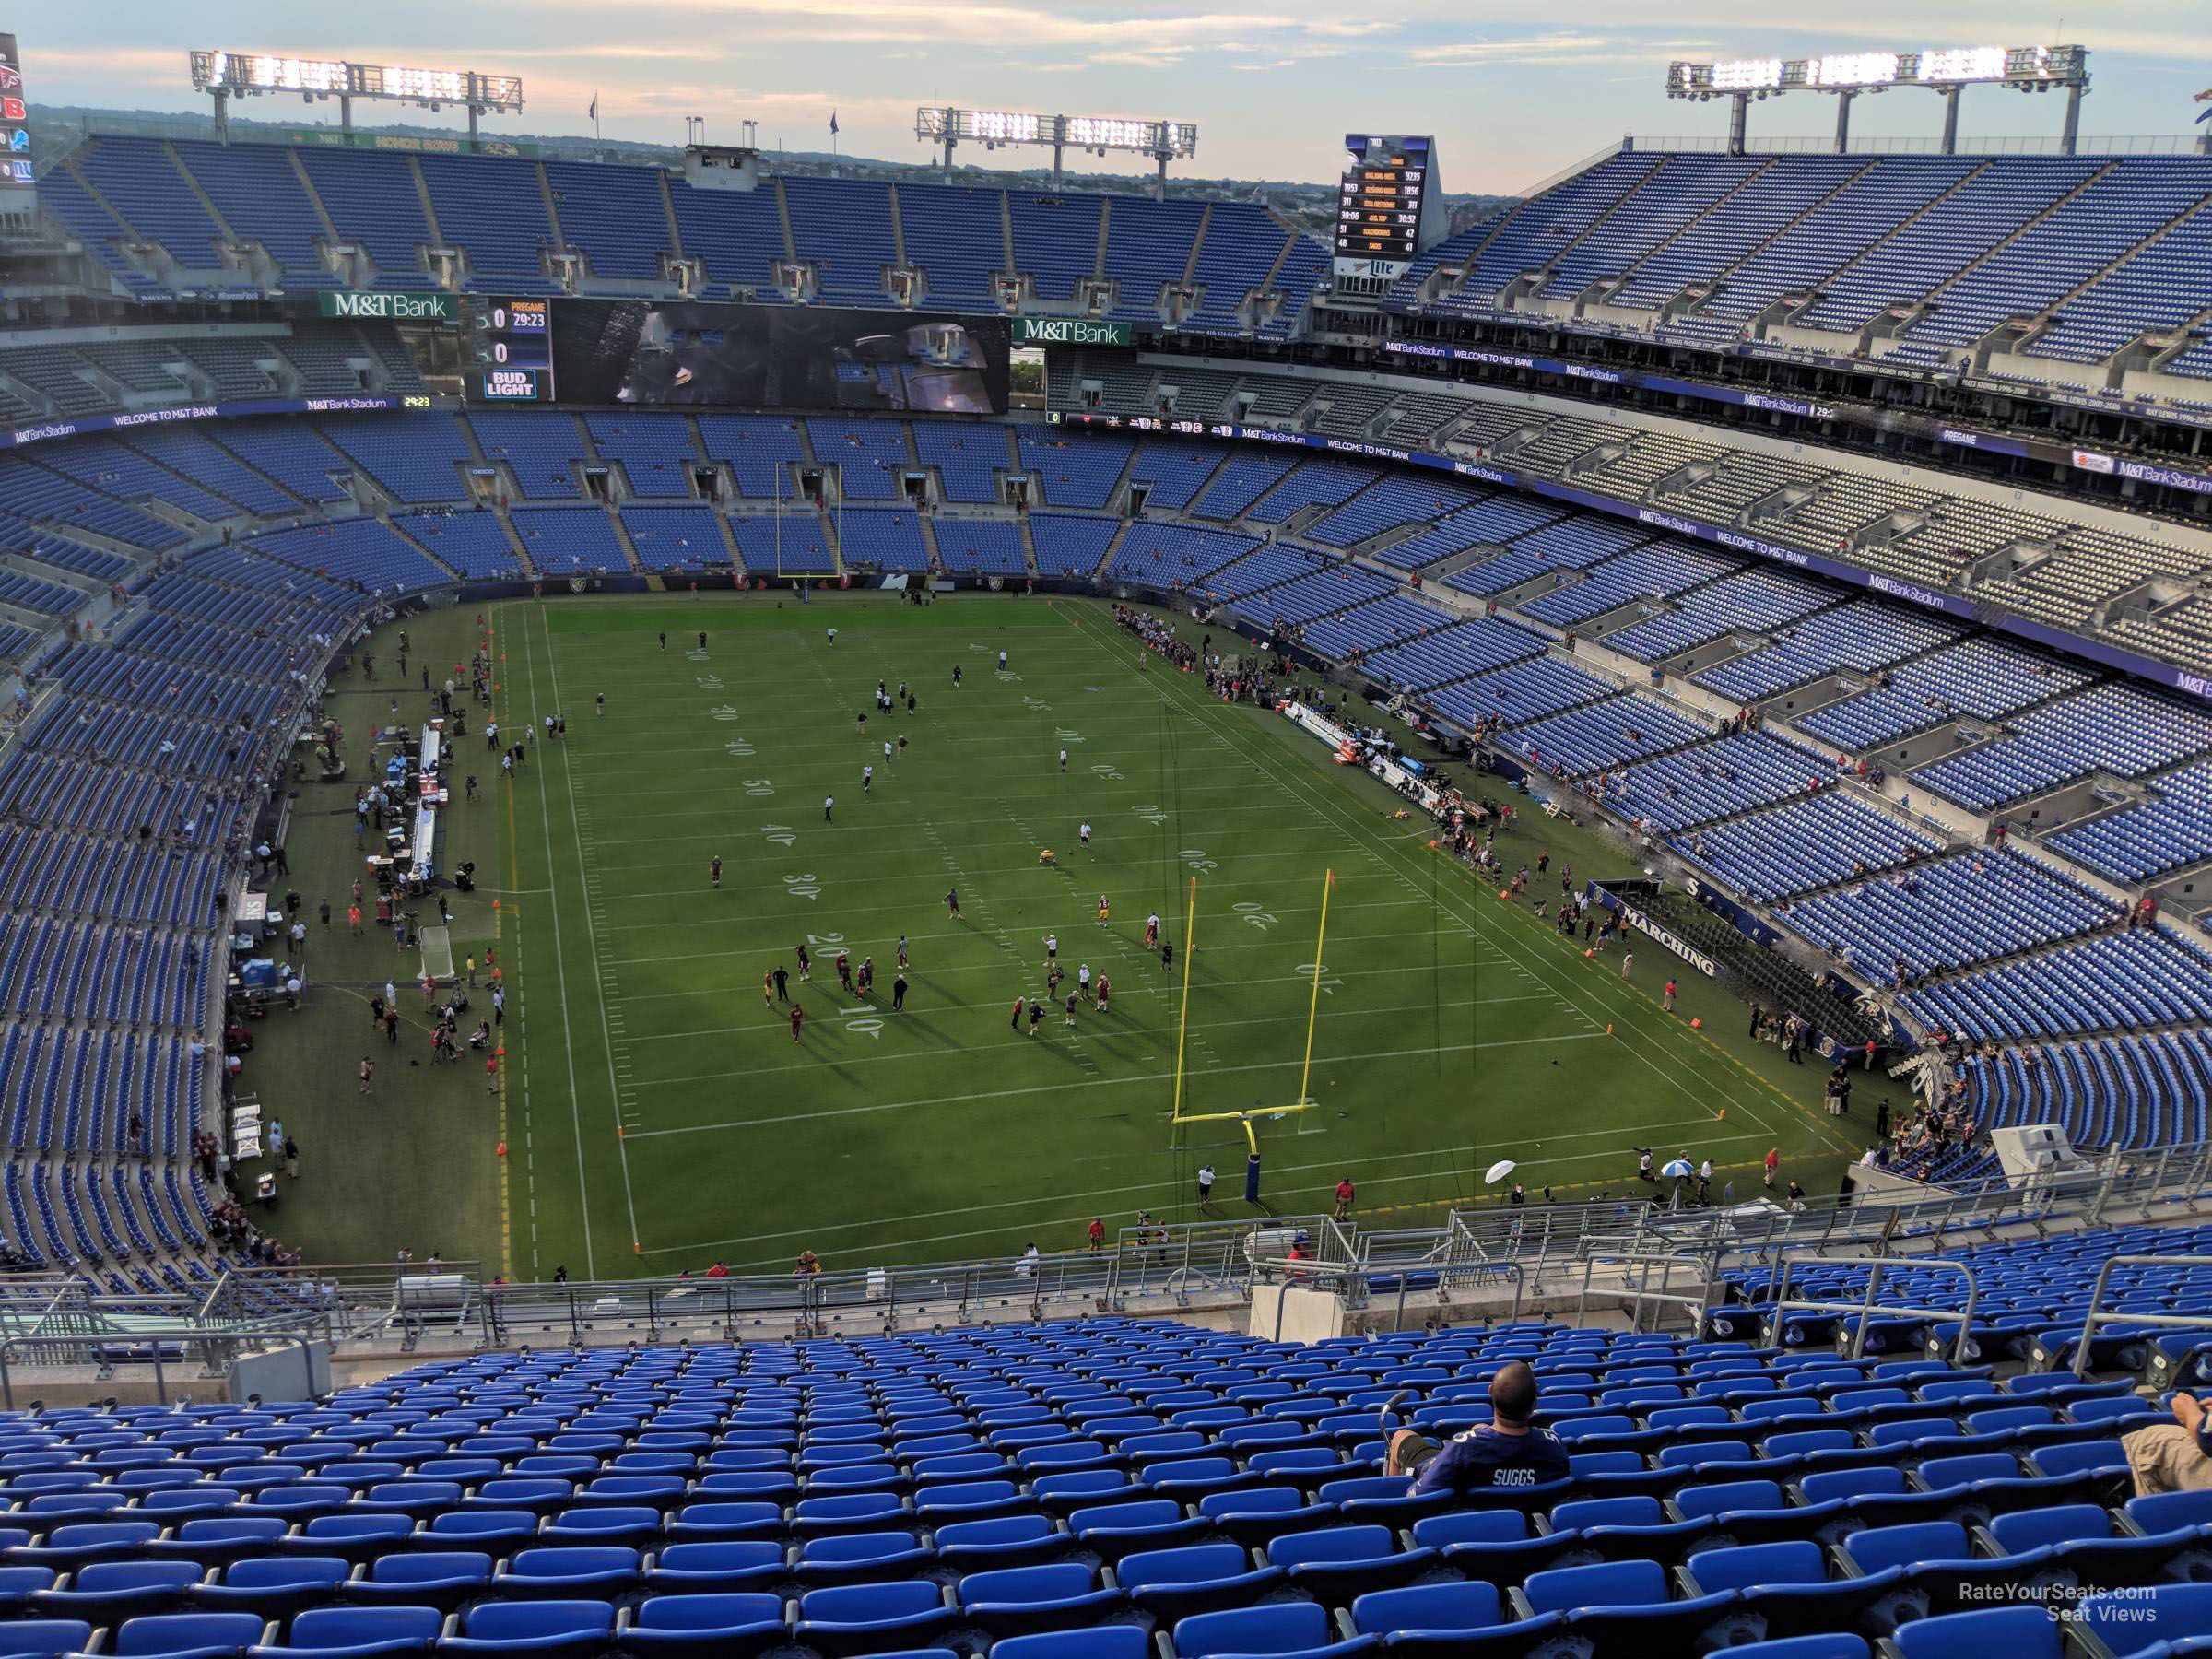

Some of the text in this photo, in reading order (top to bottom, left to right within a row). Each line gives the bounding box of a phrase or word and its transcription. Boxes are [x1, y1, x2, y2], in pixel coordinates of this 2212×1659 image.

[1405, 186, 1418, 195] 1856
[1406, 229, 1414, 238] 42
[1371, 260, 1394, 276] Lite
[334, 293, 446, 318] M&T Bank
[511, 301, 546, 312] PREGAME
[494, 309, 505, 328] 0
[513, 313, 545, 327] 29:23
[1025, 319, 1120, 344] M&T Bank
[495, 343, 507, 363] 0
[1386, 342, 1445, 358] M&T Bank Stadium
[1454, 349, 1533, 368] WELCOME TO M&T BANK
[493, 371, 526, 384] BUD
[1565, 365, 1618, 382] M&T Bank Stadium
[1853, 363, 1878, 373] JONATHAN
[1879, 367, 1896, 375] OGDEN
[487, 383, 533, 396] LIGHT
[1977, 381, 1997, 392] STOVER
[307, 397, 386, 410] M&T Bank Stadium
[405, 397, 429, 407] 29:23
[1744, 394, 1761, 406] M&T
[1761, 395, 1779, 408] Bank
[1779, 398, 1806, 414] Stadium
[2050, 393, 2067, 403] JAMAL
[2068, 394, 2087, 406] LEWIS
[114, 406, 218, 426] WELCOME TO M&T BANK
[1053, 413, 1059, 422] 0
[2146, 407, 2158, 416] RAY
[2159, 409, 2178, 419] LEWIS
[15, 424, 76, 444] M&T Bank Stadium
[1241, 429, 1306, 444] M&T Bank Stadium
[1944, 429, 1976, 445] PREGAME
[1327, 439, 1409, 461] WELCOME TO M&T BANK
[1454, 462, 1502, 482] M&T Bank Stadium
[2119, 461, 2146, 478] M&T
[2145, 466, 2170, 484] Bank
[2170, 471, 2212, 493] Stadium
[1639, 509, 1697, 535] M&T Bank Stadium
[1716, 531, 1808, 567] WELCOME TO M&T BANK
[1868, 574, 1943, 608] M&T Bank Stadium
[2176, 672, 2207, 694] M&T
[1090, 765, 1125, 780] 50
[742, 780, 775, 796] 50
[1131, 805, 1168, 821] 40
[760, 824, 797, 842] 40
[1178, 850, 1218, 869] 30
[782, 874, 821, 895] 30
[1231, 902, 1279, 924] 20
[806, 932, 850, 958] 20
[1624, 905, 1715, 977] MARCHING
[1294, 964, 1344, 986] 10
[839, 1004, 885, 1032] 10
[1492, 1468, 1535, 1487] SUGGS
